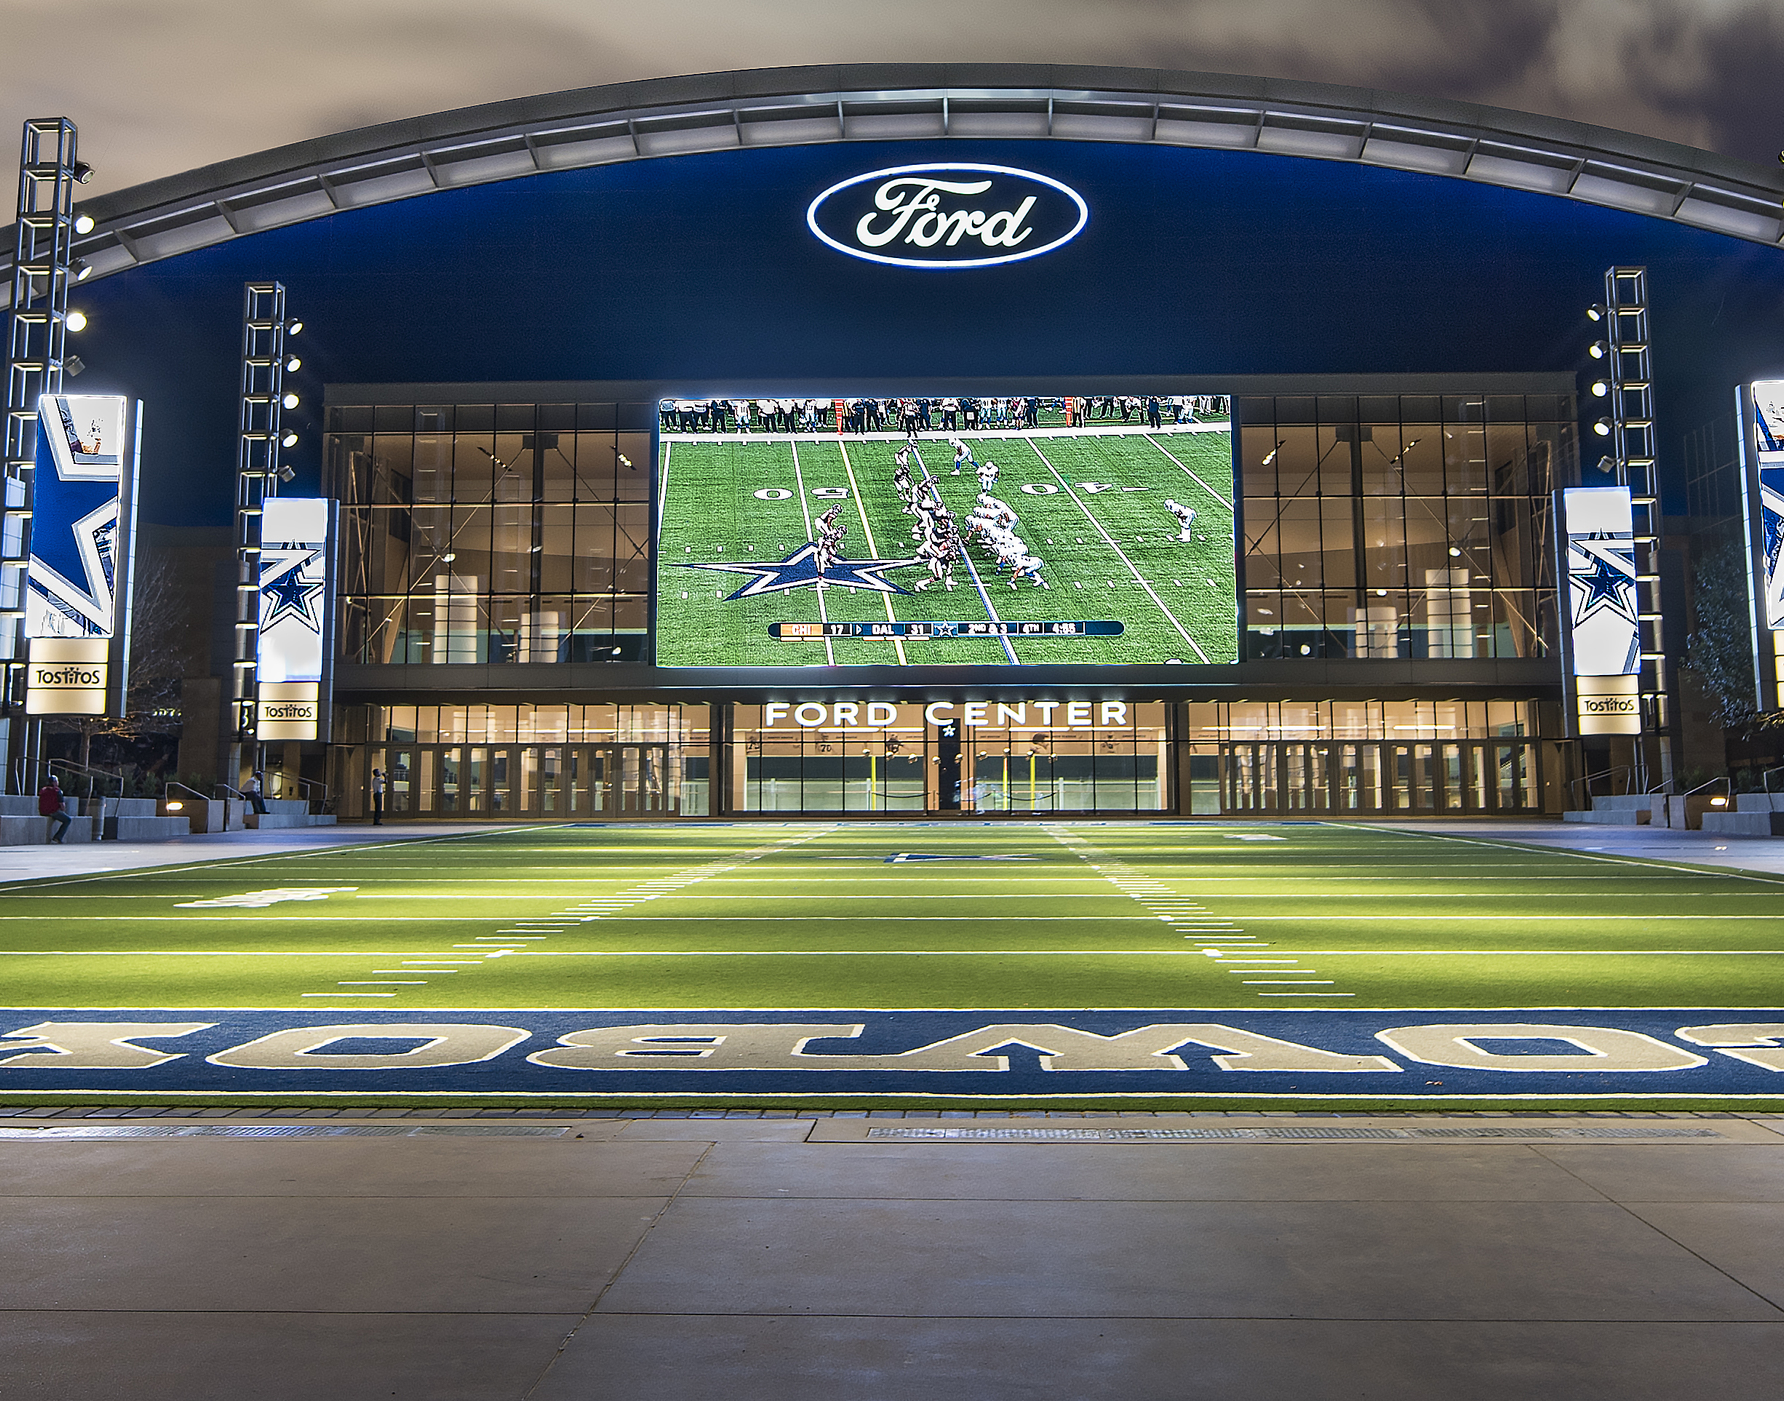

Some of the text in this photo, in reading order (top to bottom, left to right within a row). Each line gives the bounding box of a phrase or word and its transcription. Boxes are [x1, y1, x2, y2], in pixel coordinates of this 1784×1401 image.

[856, 177, 1037, 247] Ford
[791, 624, 811, 636] CHI
[830, 624, 844, 635] 17
[872, 624, 895, 635] DAL
[910, 624, 924, 635] 31
[1022, 623, 1040, 634] 4TH
[766, 701, 1128, 727] FORD CENTER
